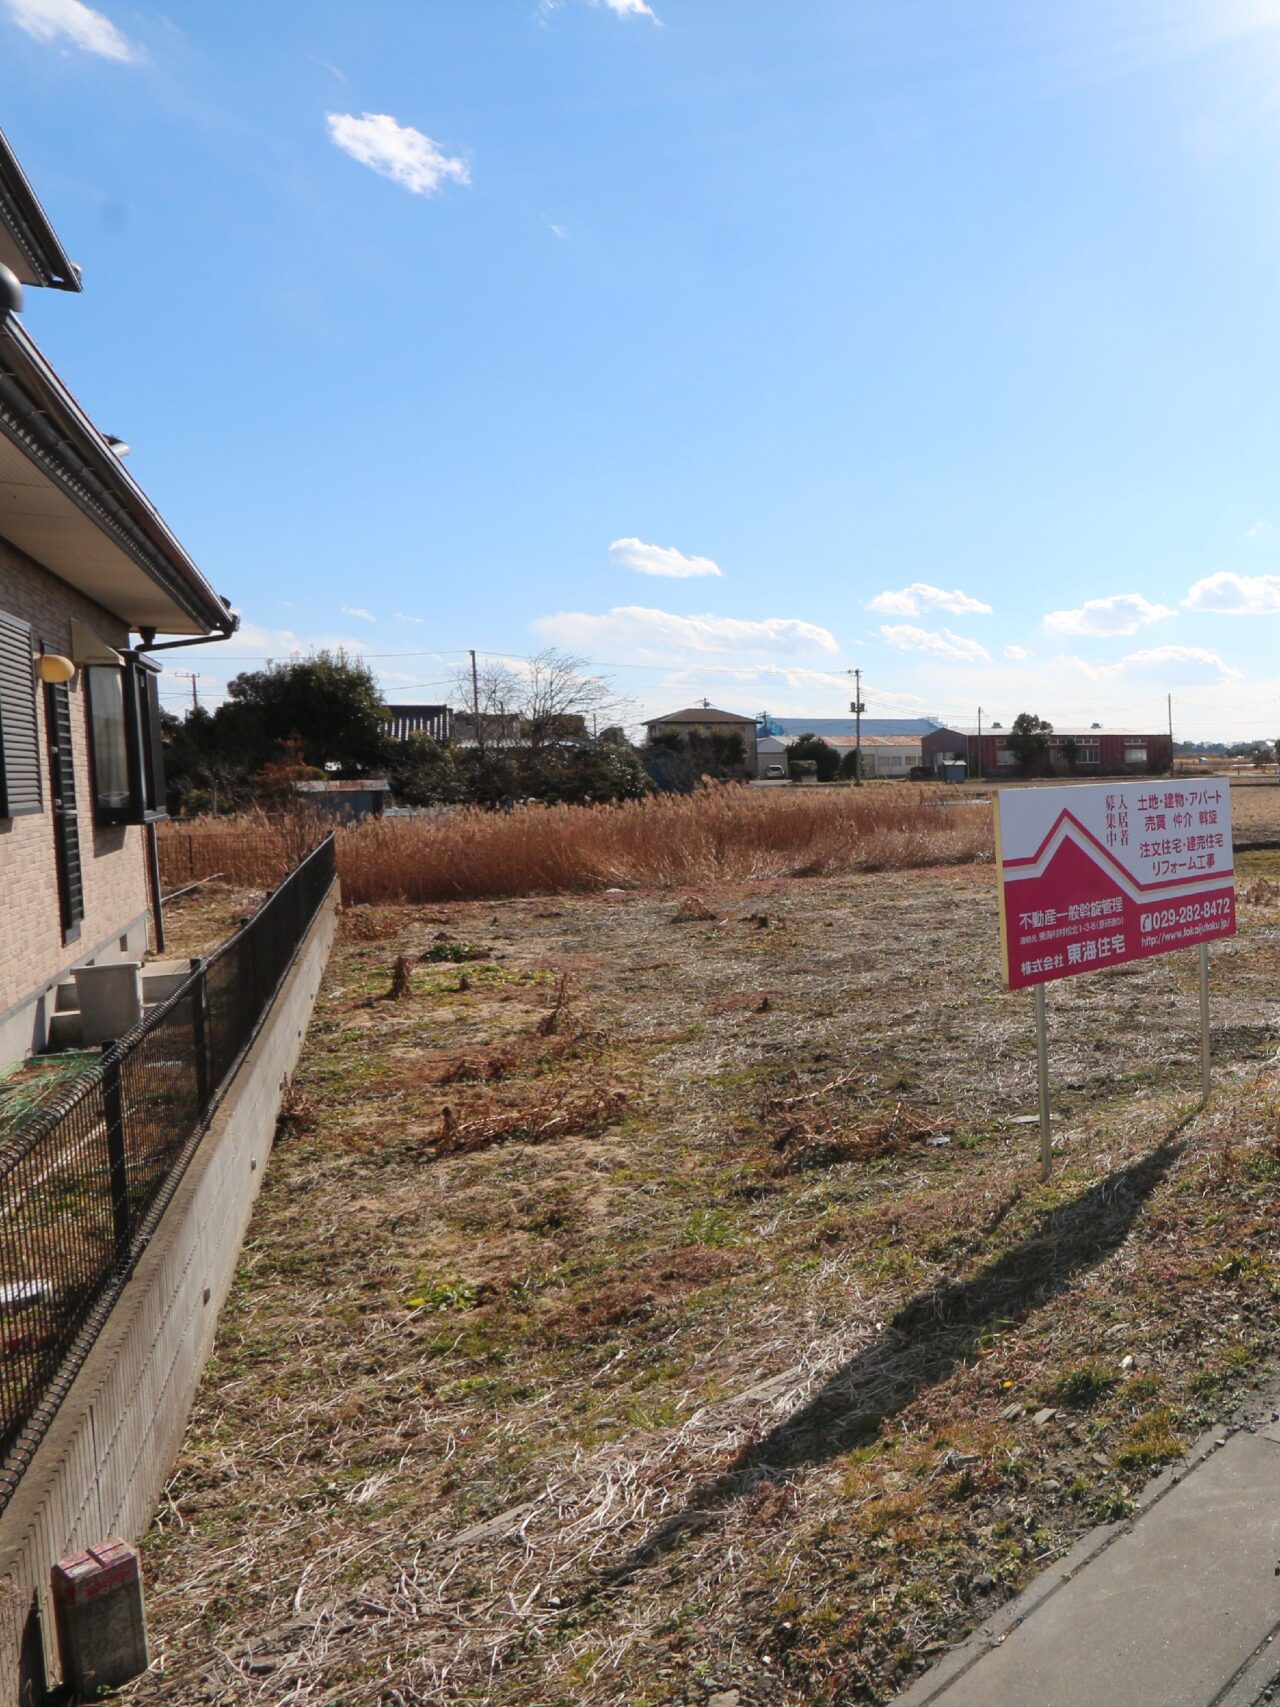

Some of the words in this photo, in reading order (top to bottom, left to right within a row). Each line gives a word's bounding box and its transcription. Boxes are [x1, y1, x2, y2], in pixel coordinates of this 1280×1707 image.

[1105, 794, 1117, 847] 募集中
[1118, 793, 1129, 846] 入居者
[1145, 814, 1166, 832] 売買
[1173, 812, 1192, 828] 仲介
[1152, 853, 1215, 876] リフォーム工事
[1152, 897, 1230, 929] 029-282-8472
[1021, 953, 1064, 976] 株式会社
[1066, 934, 1126, 965] 東海住宅
